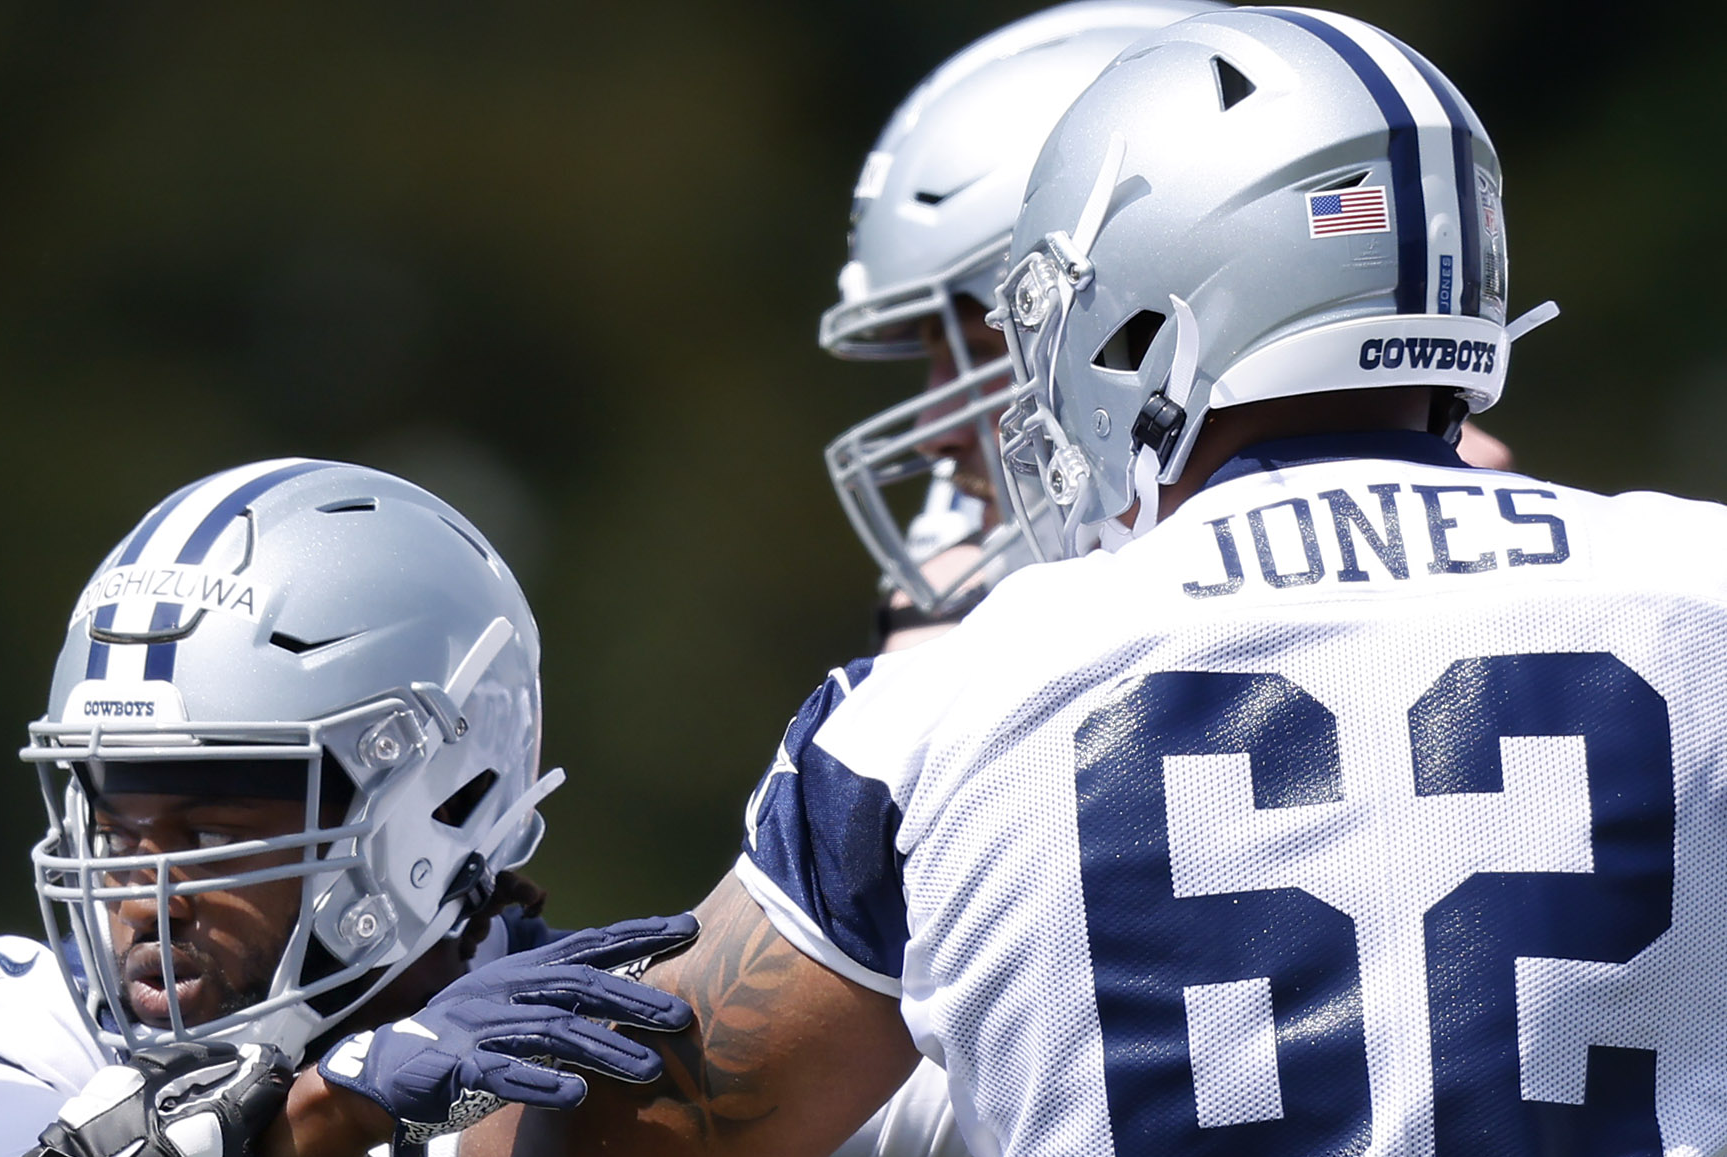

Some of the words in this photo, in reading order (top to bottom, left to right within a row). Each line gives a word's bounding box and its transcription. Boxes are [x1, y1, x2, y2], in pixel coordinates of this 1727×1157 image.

[1440, 256, 1452, 308] JONES
[1359, 337, 1496, 375] COWBOYS
[1182, 482, 1570, 600] JONES
[84, 700, 155, 717] COWBOYS
